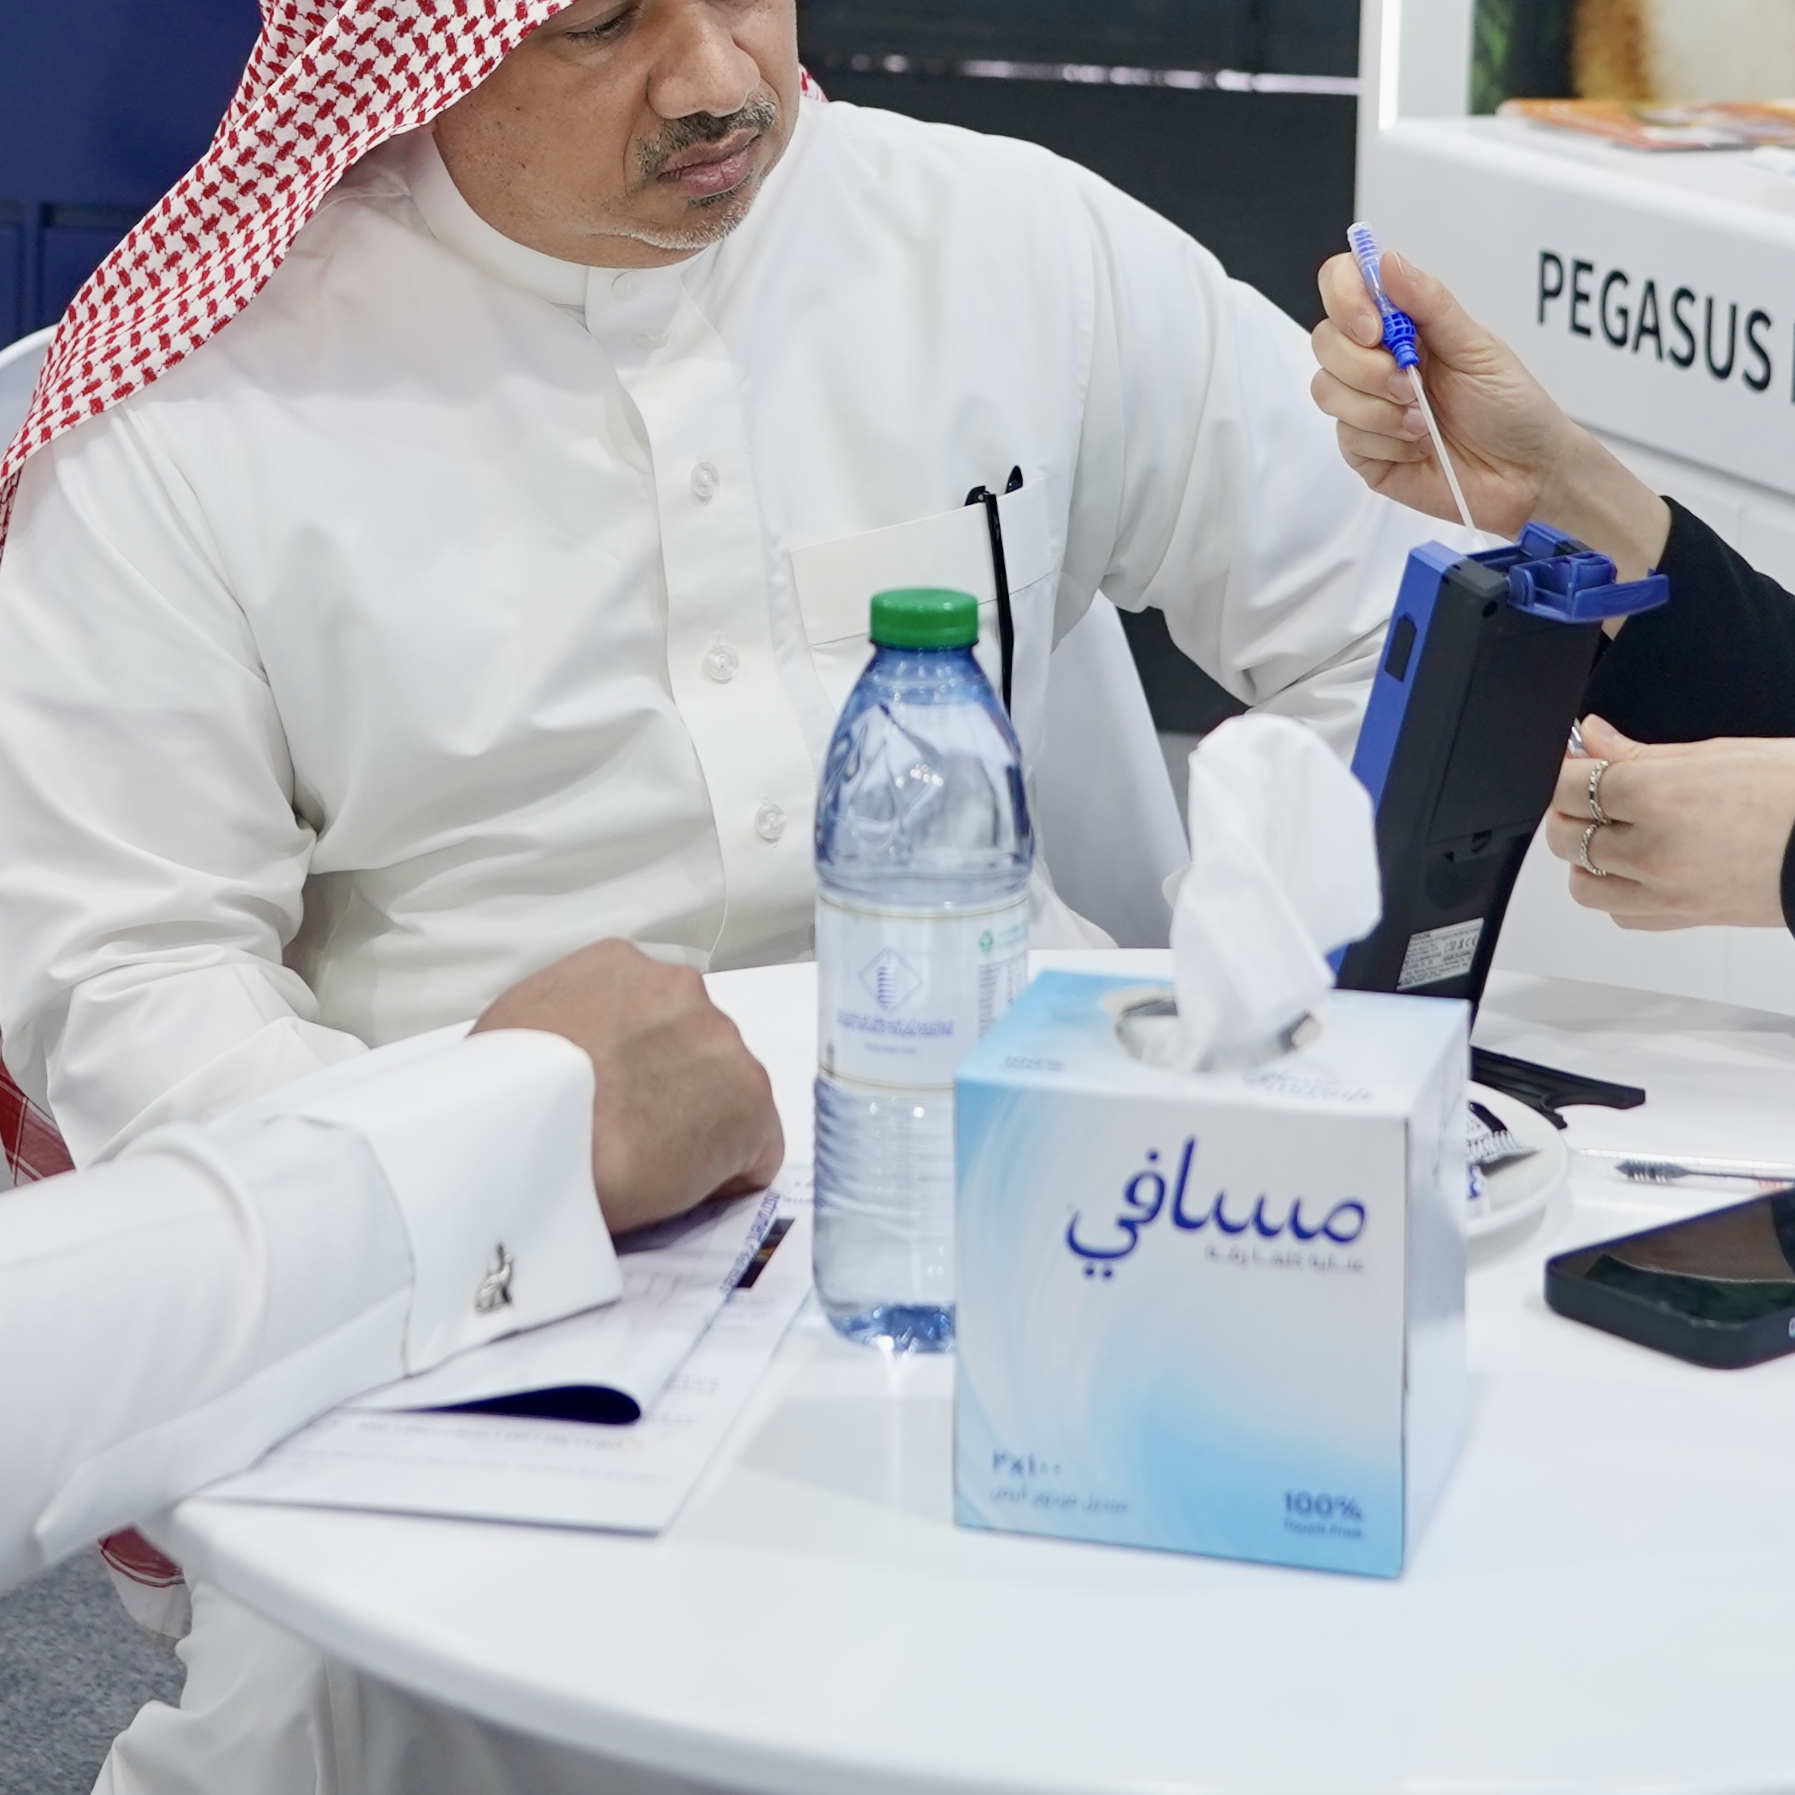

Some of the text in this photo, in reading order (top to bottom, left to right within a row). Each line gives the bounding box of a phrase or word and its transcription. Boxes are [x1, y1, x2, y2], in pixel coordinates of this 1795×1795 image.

[1537, 249, 1773, 392] PEGASUS
[1065, 1135, 1366, 1281] مسافي
[1284, 1491, 1362, 1520] 100%
